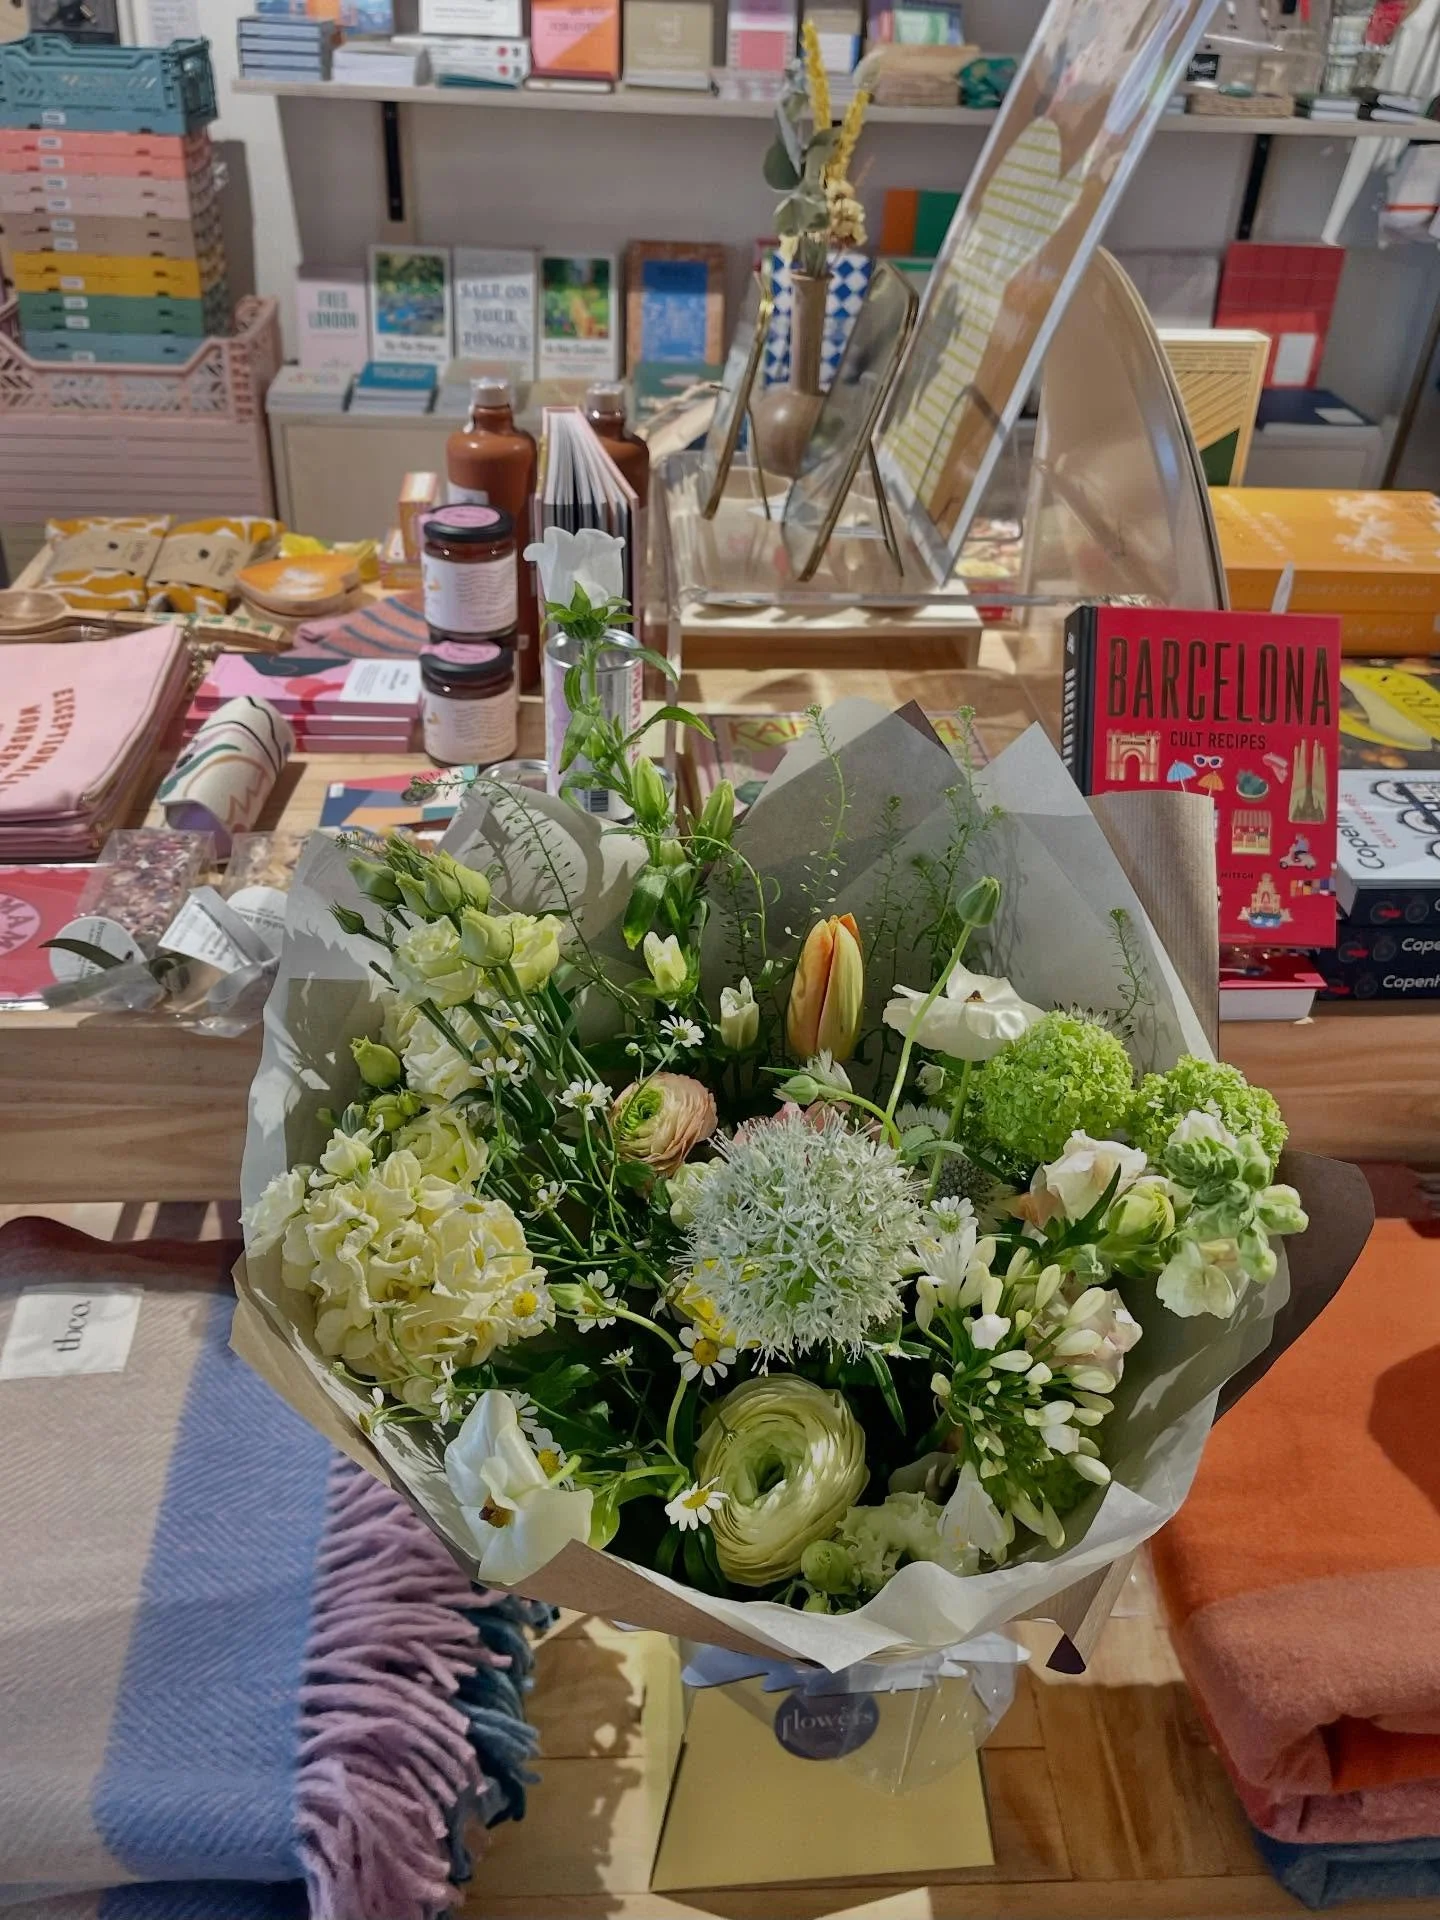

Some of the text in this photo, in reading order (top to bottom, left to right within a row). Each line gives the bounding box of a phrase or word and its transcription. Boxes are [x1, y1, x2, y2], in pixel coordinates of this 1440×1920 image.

[1107, 636, 1332, 727] BARCELONA
[1169, 730, 1267, 750] CULT RECIPES
